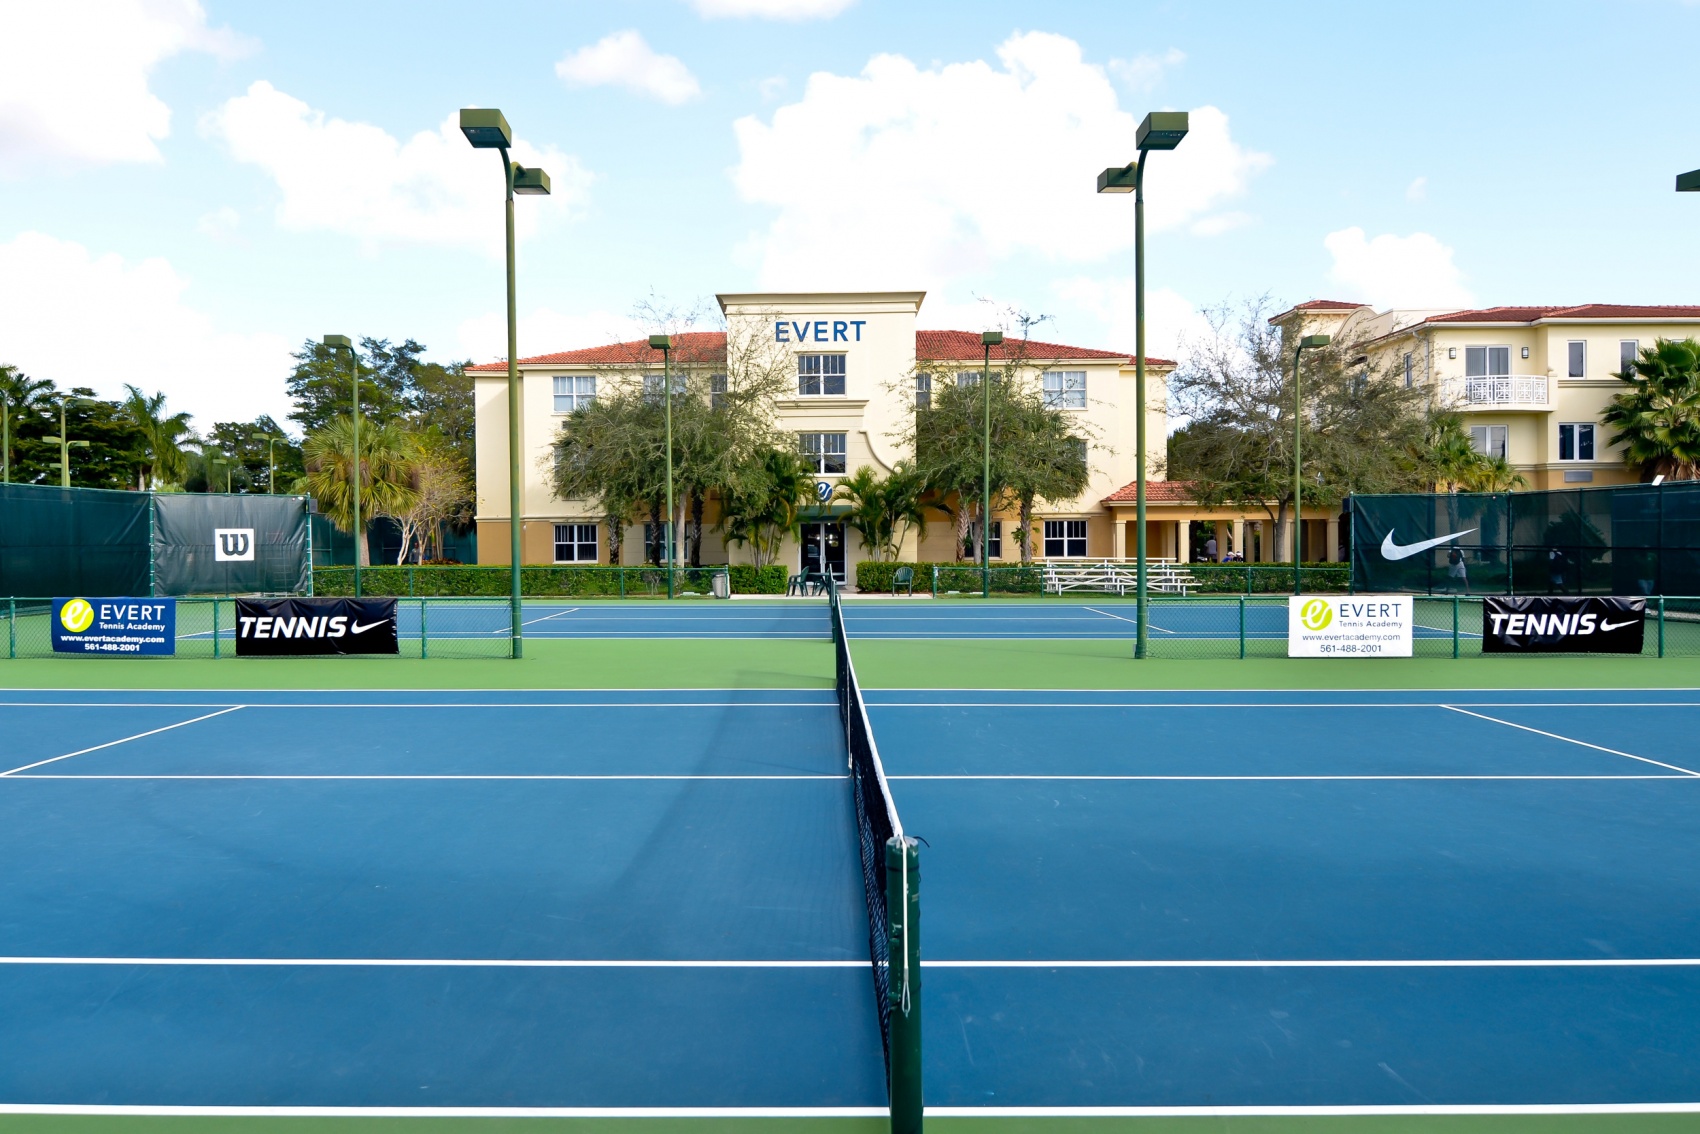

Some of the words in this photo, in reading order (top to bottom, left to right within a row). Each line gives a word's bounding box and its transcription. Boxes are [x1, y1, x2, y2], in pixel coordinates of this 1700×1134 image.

[775, 321, 866, 342] EVERT
[100, 604, 166, 620] EVERT
[1340, 603, 1402, 618] EVERT
[99, 622, 125, 630] Tennis
[126, 623, 166, 632] Academy
[239, 616, 348, 638] TENNIS
[1366, 620, 1403, 629] Academy
[1490, 613, 1597, 635] TENNIS
[60, 635, 165, 644] www.evertacademy.com
[1302, 633, 1401, 642] www.evertacademy.com
[84, 643, 140, 651] 561-488-2001
[1320, 644, 1382, 653] 561-488-2001
